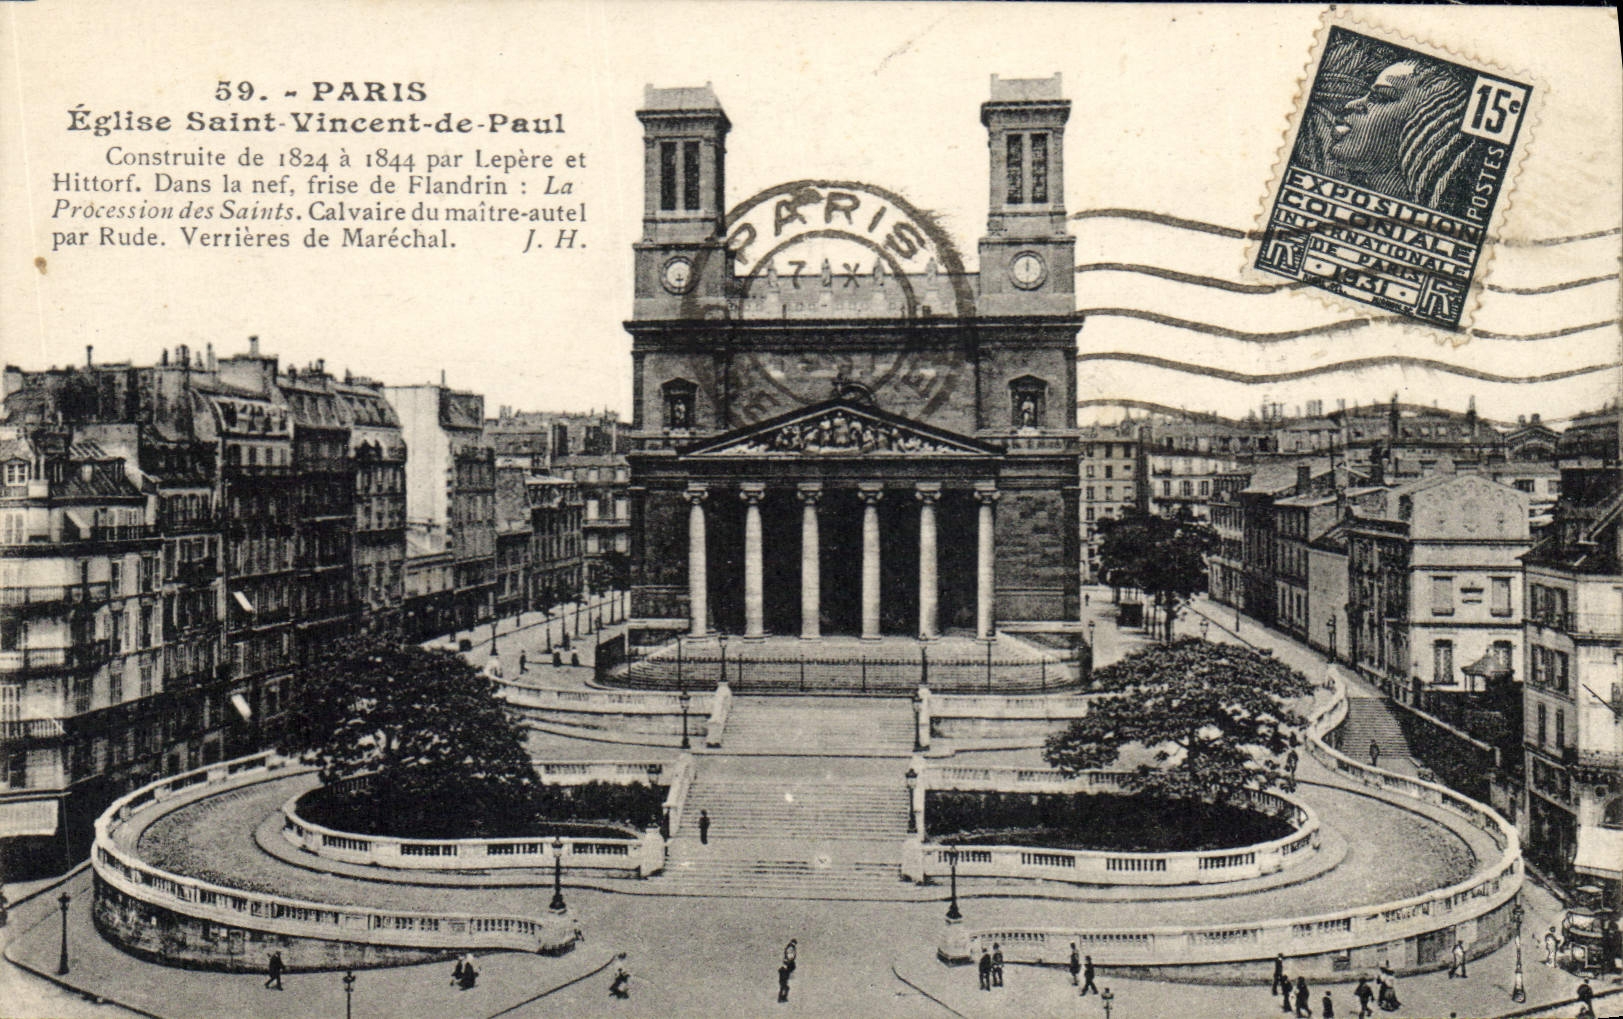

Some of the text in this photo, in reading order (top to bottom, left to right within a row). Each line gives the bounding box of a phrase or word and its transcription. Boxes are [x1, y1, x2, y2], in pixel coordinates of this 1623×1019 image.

[1286, 171, 1482, 242] EXPOSITION
[1469, 145, 1505, 221] POSTES
[727, 190, 927, 266] PARIS
[1274, 209, 1469, 278] INTERNATIONALE
[1280, 190, 1475, 261] COLONIALE
[1311, 238, 1424, 284] DE PARIS
[1332, 266, 1388, 295] 1931
